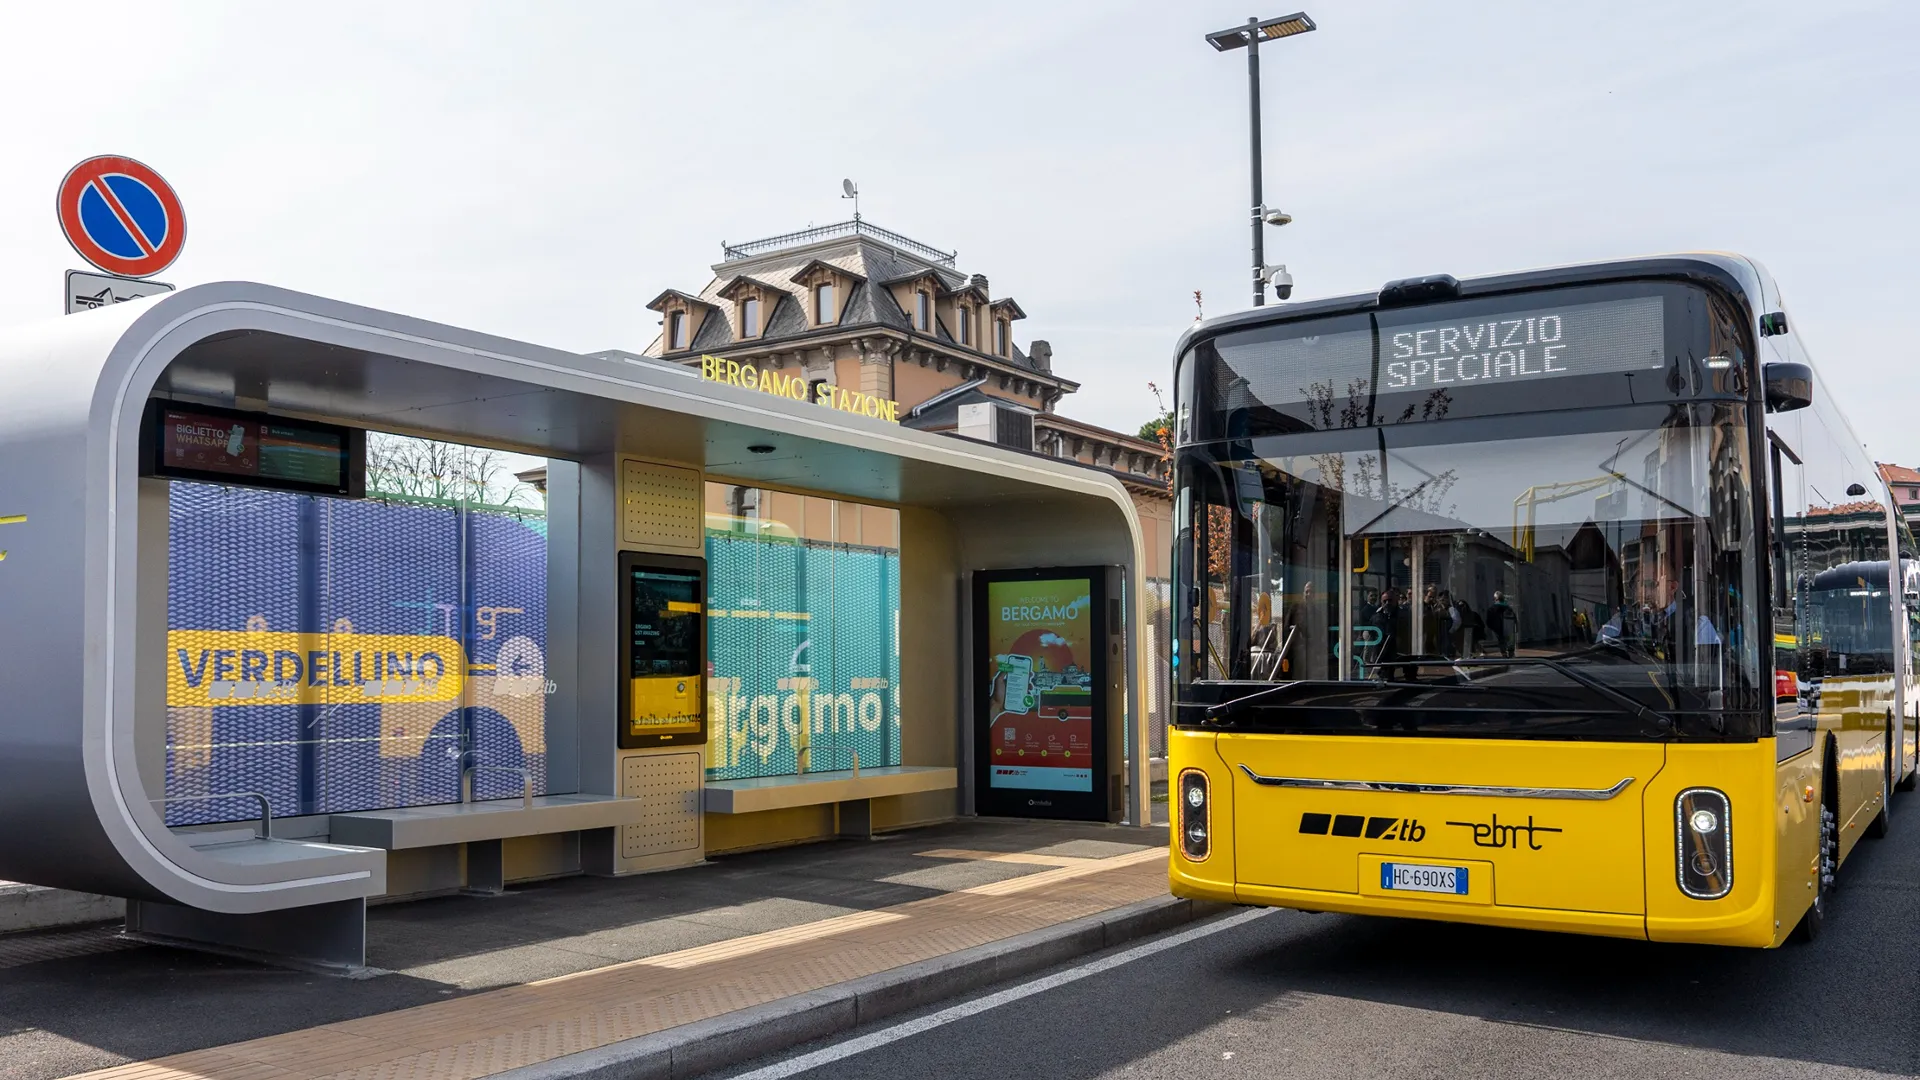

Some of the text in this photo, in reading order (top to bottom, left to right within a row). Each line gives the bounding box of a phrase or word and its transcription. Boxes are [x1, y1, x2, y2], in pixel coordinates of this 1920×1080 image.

[1393, 315, 1562, 358] SERVIZIO
[1388, 345, 1566, 387] SPECIALE
[701, 354, 900, 423] BERGAMO STAZIONE
[176, 424, 224, 439] BIGLIETTO
[176, 434, 228, 448] WHATSAPP
[1001, 605, 1078, 620] BERGAMO
[177, 647, 445, 689] VERDELLINO
